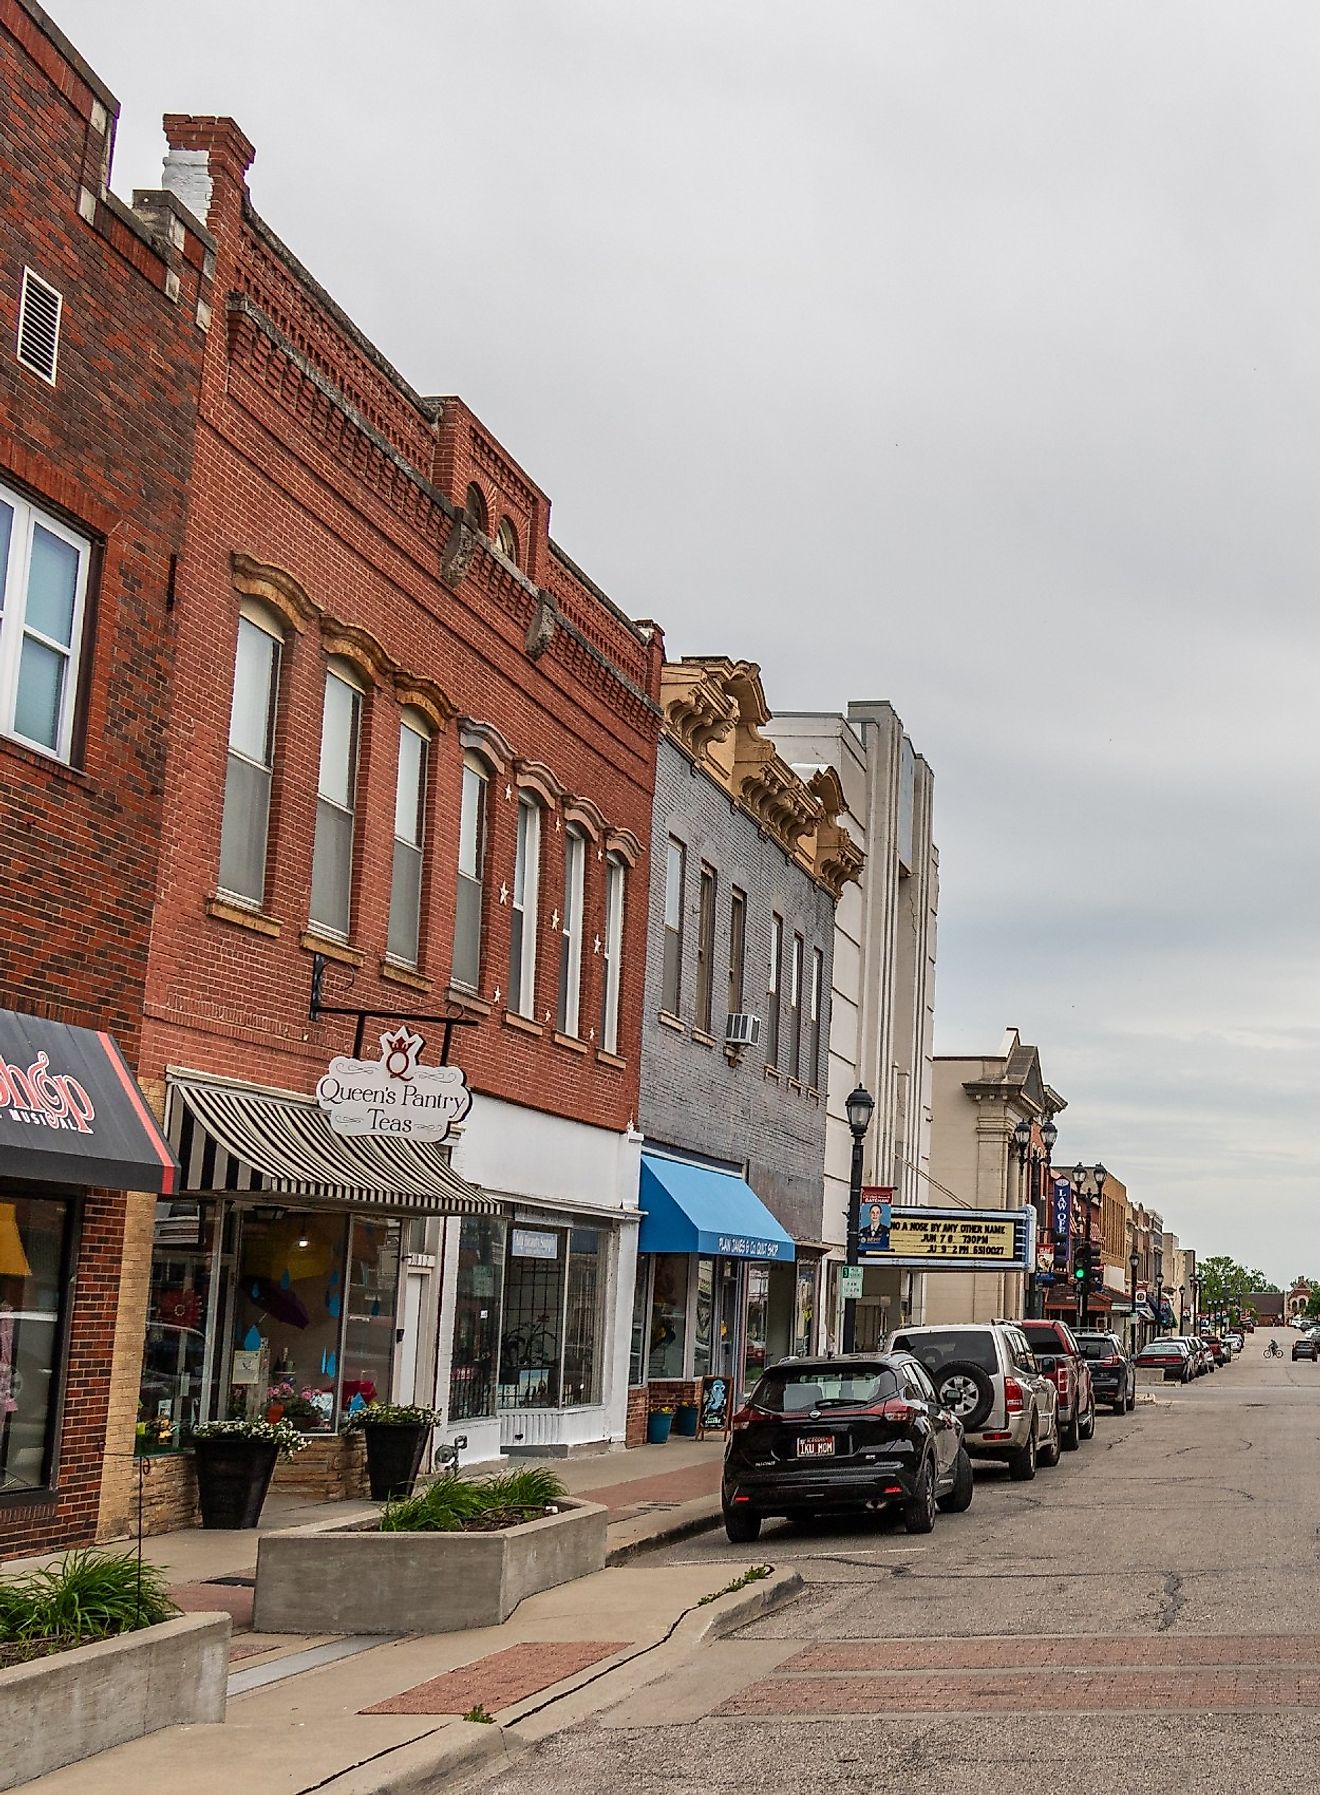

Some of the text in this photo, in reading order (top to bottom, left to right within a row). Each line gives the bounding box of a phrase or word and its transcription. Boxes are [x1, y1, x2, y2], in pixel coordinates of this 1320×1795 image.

[386, 1050, 414, 1081] Q
[320, 1078, 466, 1118] Queen's Pantry
[9, 1108, 78, 1130] MUSIAL
[366, 1108, 412, 1132] Teas
[902, 1222, 908, 1230] A
[910, 1222, 928, 1232] NOSE
[931, 1223, 941, 1232] BY
[943, 1224, 958, 1233] ANY
[960, 1224, 982, 1233] OTHER
[984, 1225, 1006, 1235] NAME
[767, 1243, 779, 1256] SHOP
